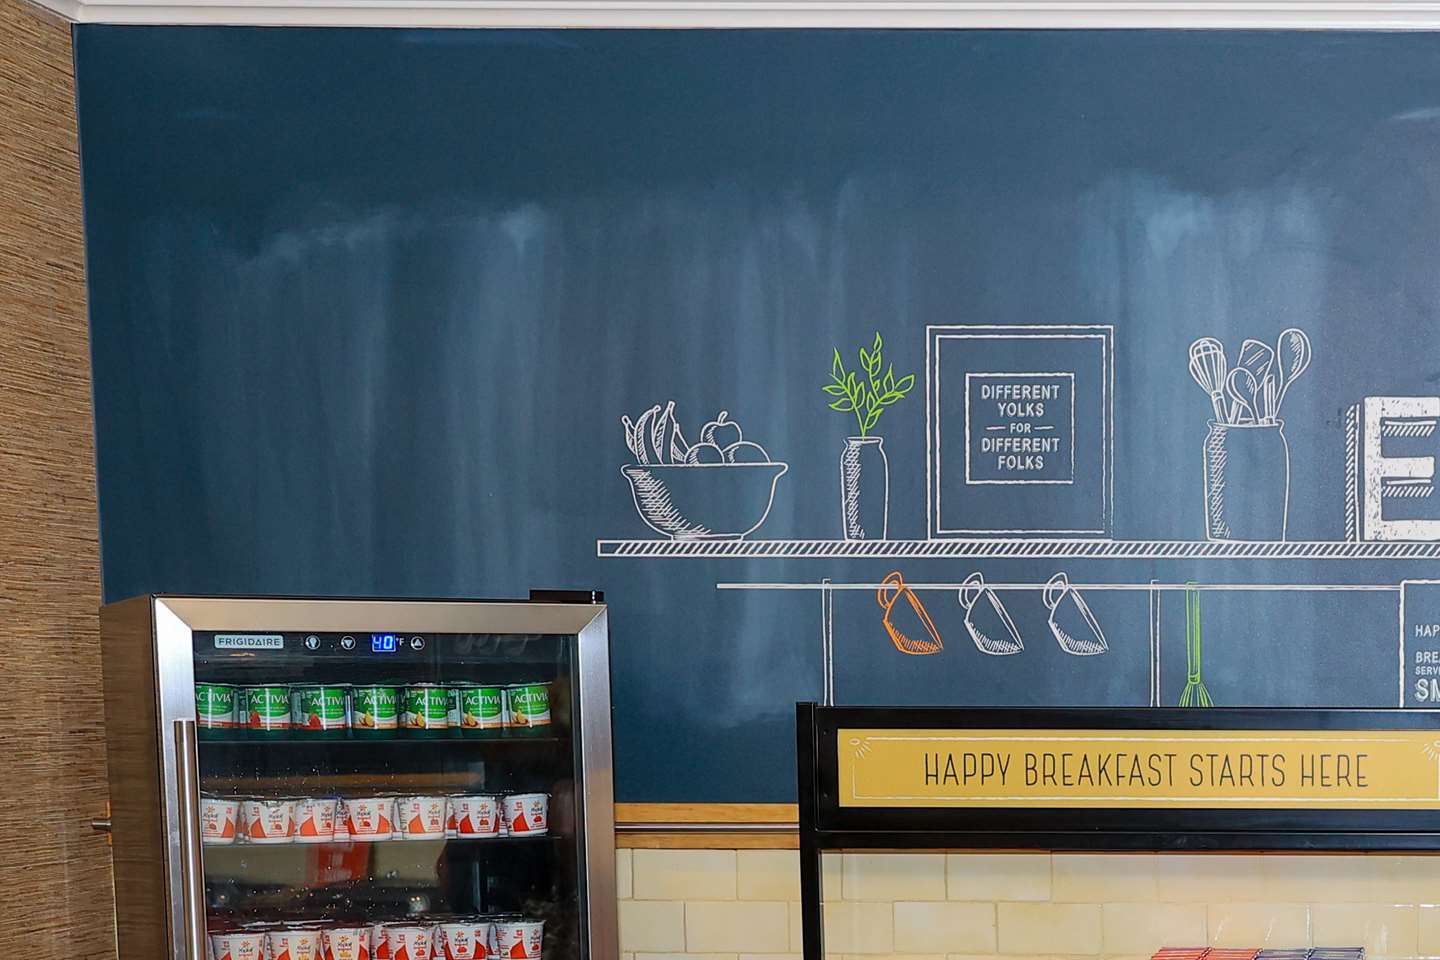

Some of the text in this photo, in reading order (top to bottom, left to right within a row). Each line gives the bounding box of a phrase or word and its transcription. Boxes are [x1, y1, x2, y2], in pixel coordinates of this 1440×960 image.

[981, 384, 1060, 400] DIFFERENT
[998, 402, 1044, 417] YOLKS
[1010, 422, 1031, 434] FOR
[981, 437, 1060, 453] DIFFERENT
[998, 455, 1044, 470] FOLKS
[218, 638, 281, 647] FRIGIDAIRE
[373, 636, 393, 649] 40
[924, 752, 1369, 788] HAPPY BREAKFAST STARTS HERE
